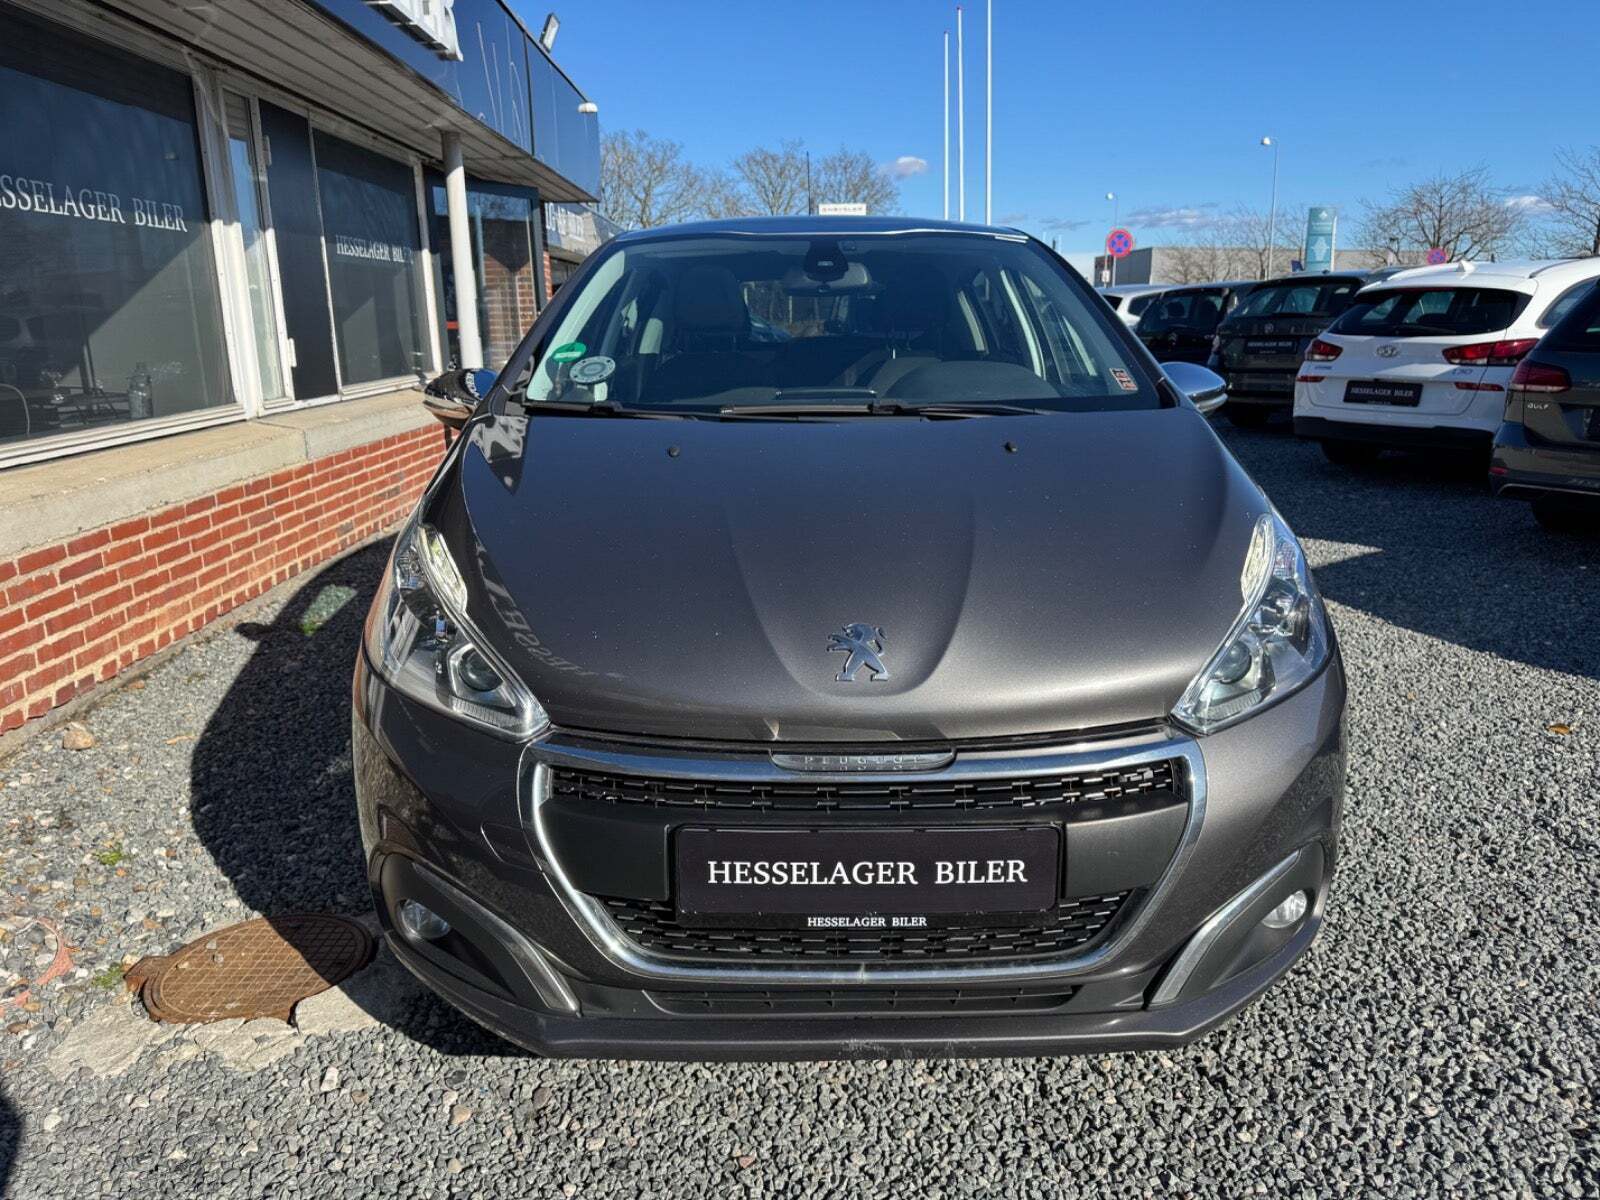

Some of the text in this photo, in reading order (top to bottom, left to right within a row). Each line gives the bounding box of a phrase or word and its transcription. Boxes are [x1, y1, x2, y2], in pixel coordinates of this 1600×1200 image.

[0, 175, 188, 233] SSELAGER BILER
[335, 234, 391, 261] HESSELAGER
[707, 859, 1028, 885] HESSELAGER BILER
[806, 917, 927, 928] HESSELAGER BILER
